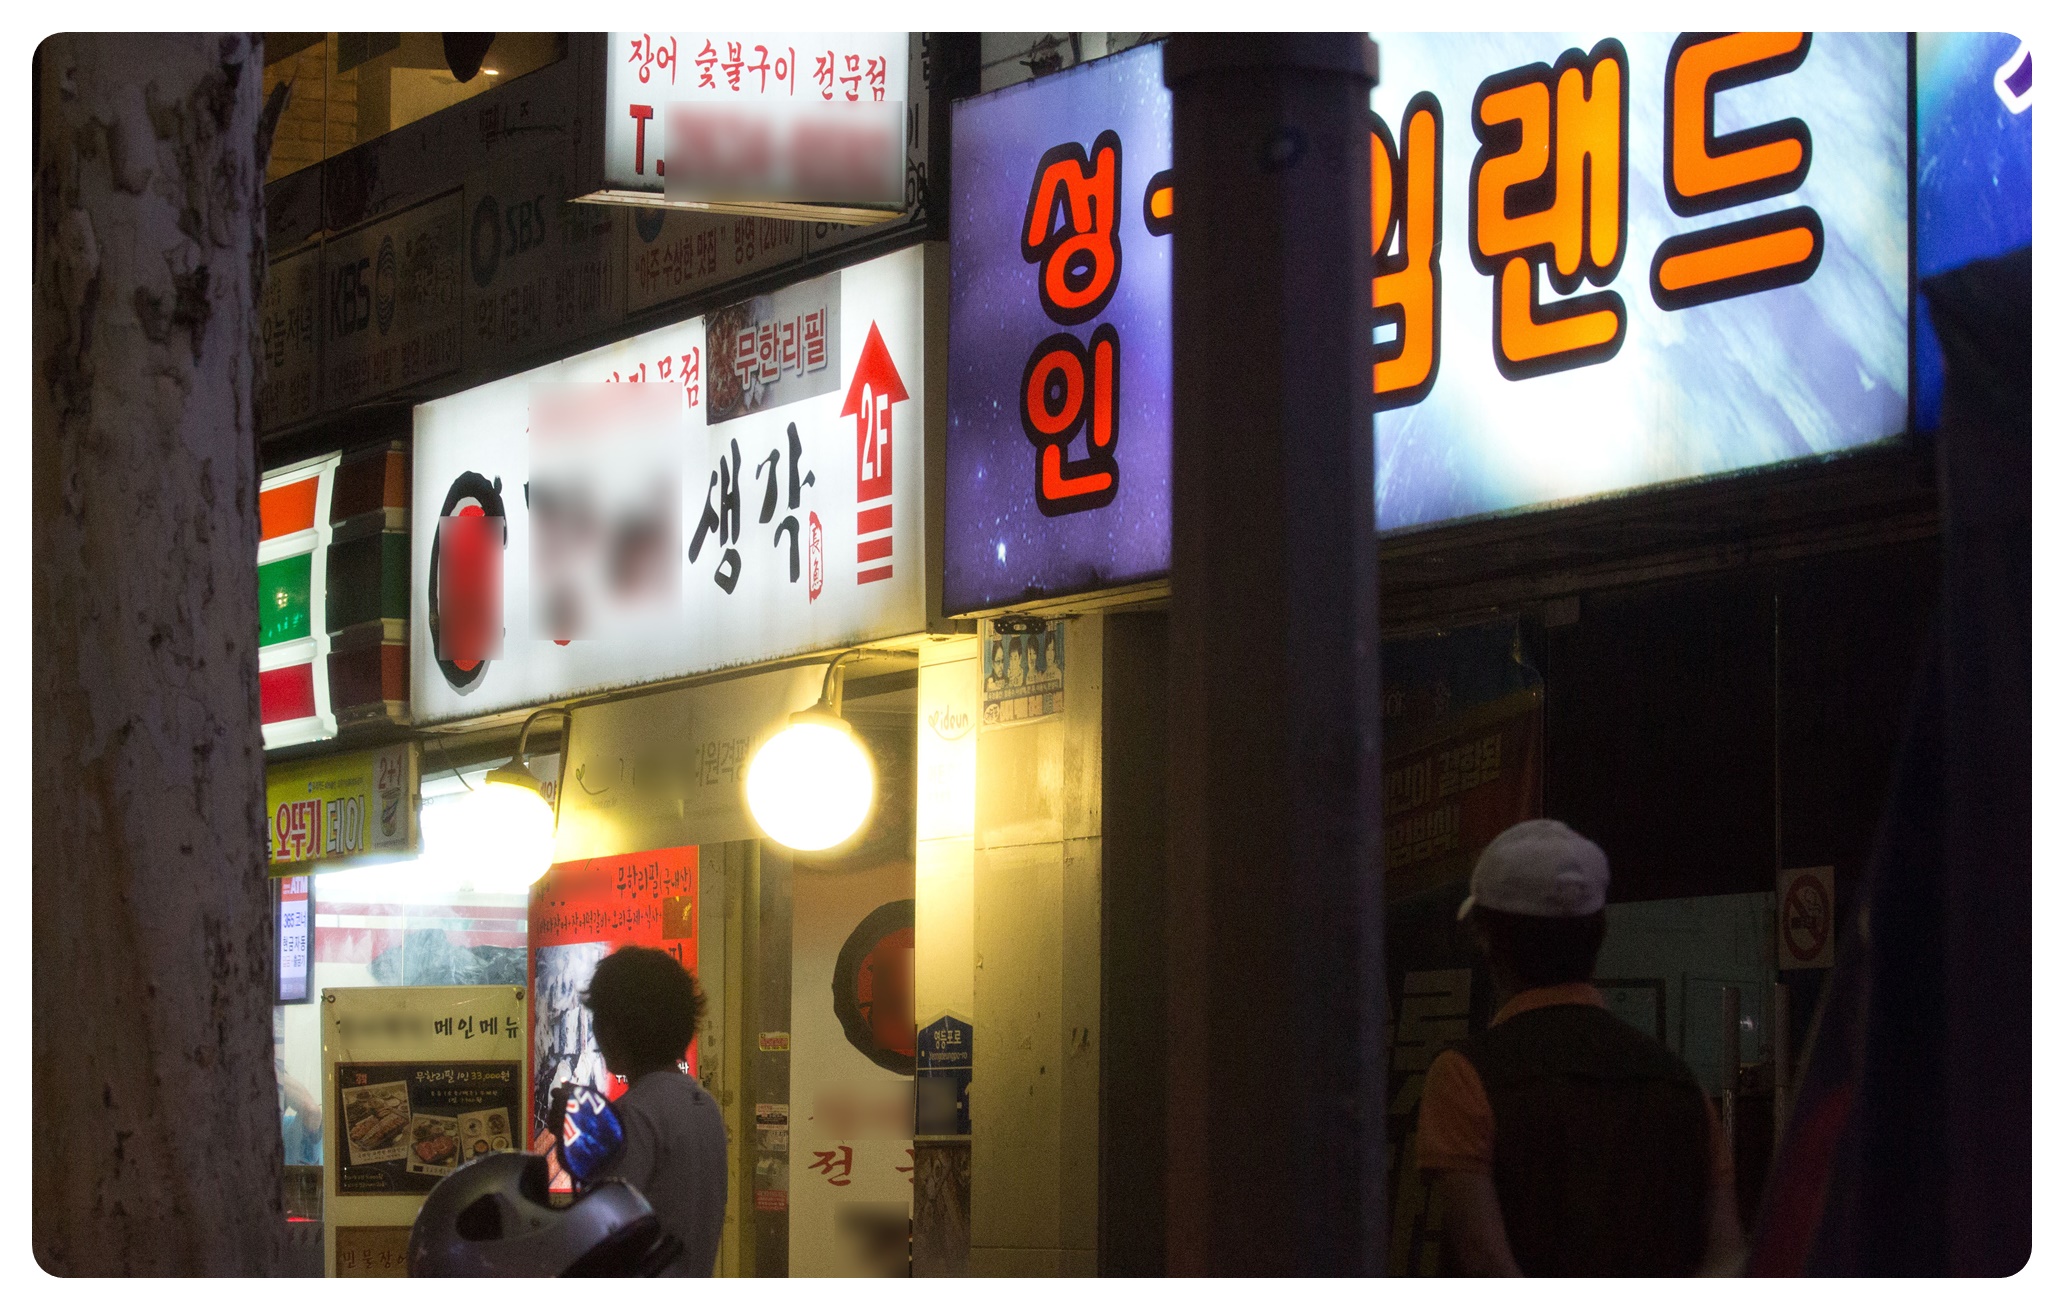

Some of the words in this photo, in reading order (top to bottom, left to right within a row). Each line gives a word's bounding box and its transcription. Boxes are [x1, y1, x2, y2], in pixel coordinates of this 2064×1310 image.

[628, 33, 676, 85] 장어
[694, 38, 794, 96] 숯불구이
[812, 50, 886, 102] 전문점
[506, 194, 545, 256] SBS
[329, 256, 371, 343] KBS
[1022, 130, 1122, 519] 성인
[735, 312, 828, 390] 무한리필
[860, 382, 890, 480] 2F
[688, 421, 817, 599] 생각
[379, 756, 405, 789] 2+1
[275, 800, 321, 861] 오뚜기
[325, 795, 363, 855] 데이
[283, 912, 295, 928] 365
[933, 1029, 962, 1050] 영등포로
[415, 1070, 454, 1085] 무한리필
